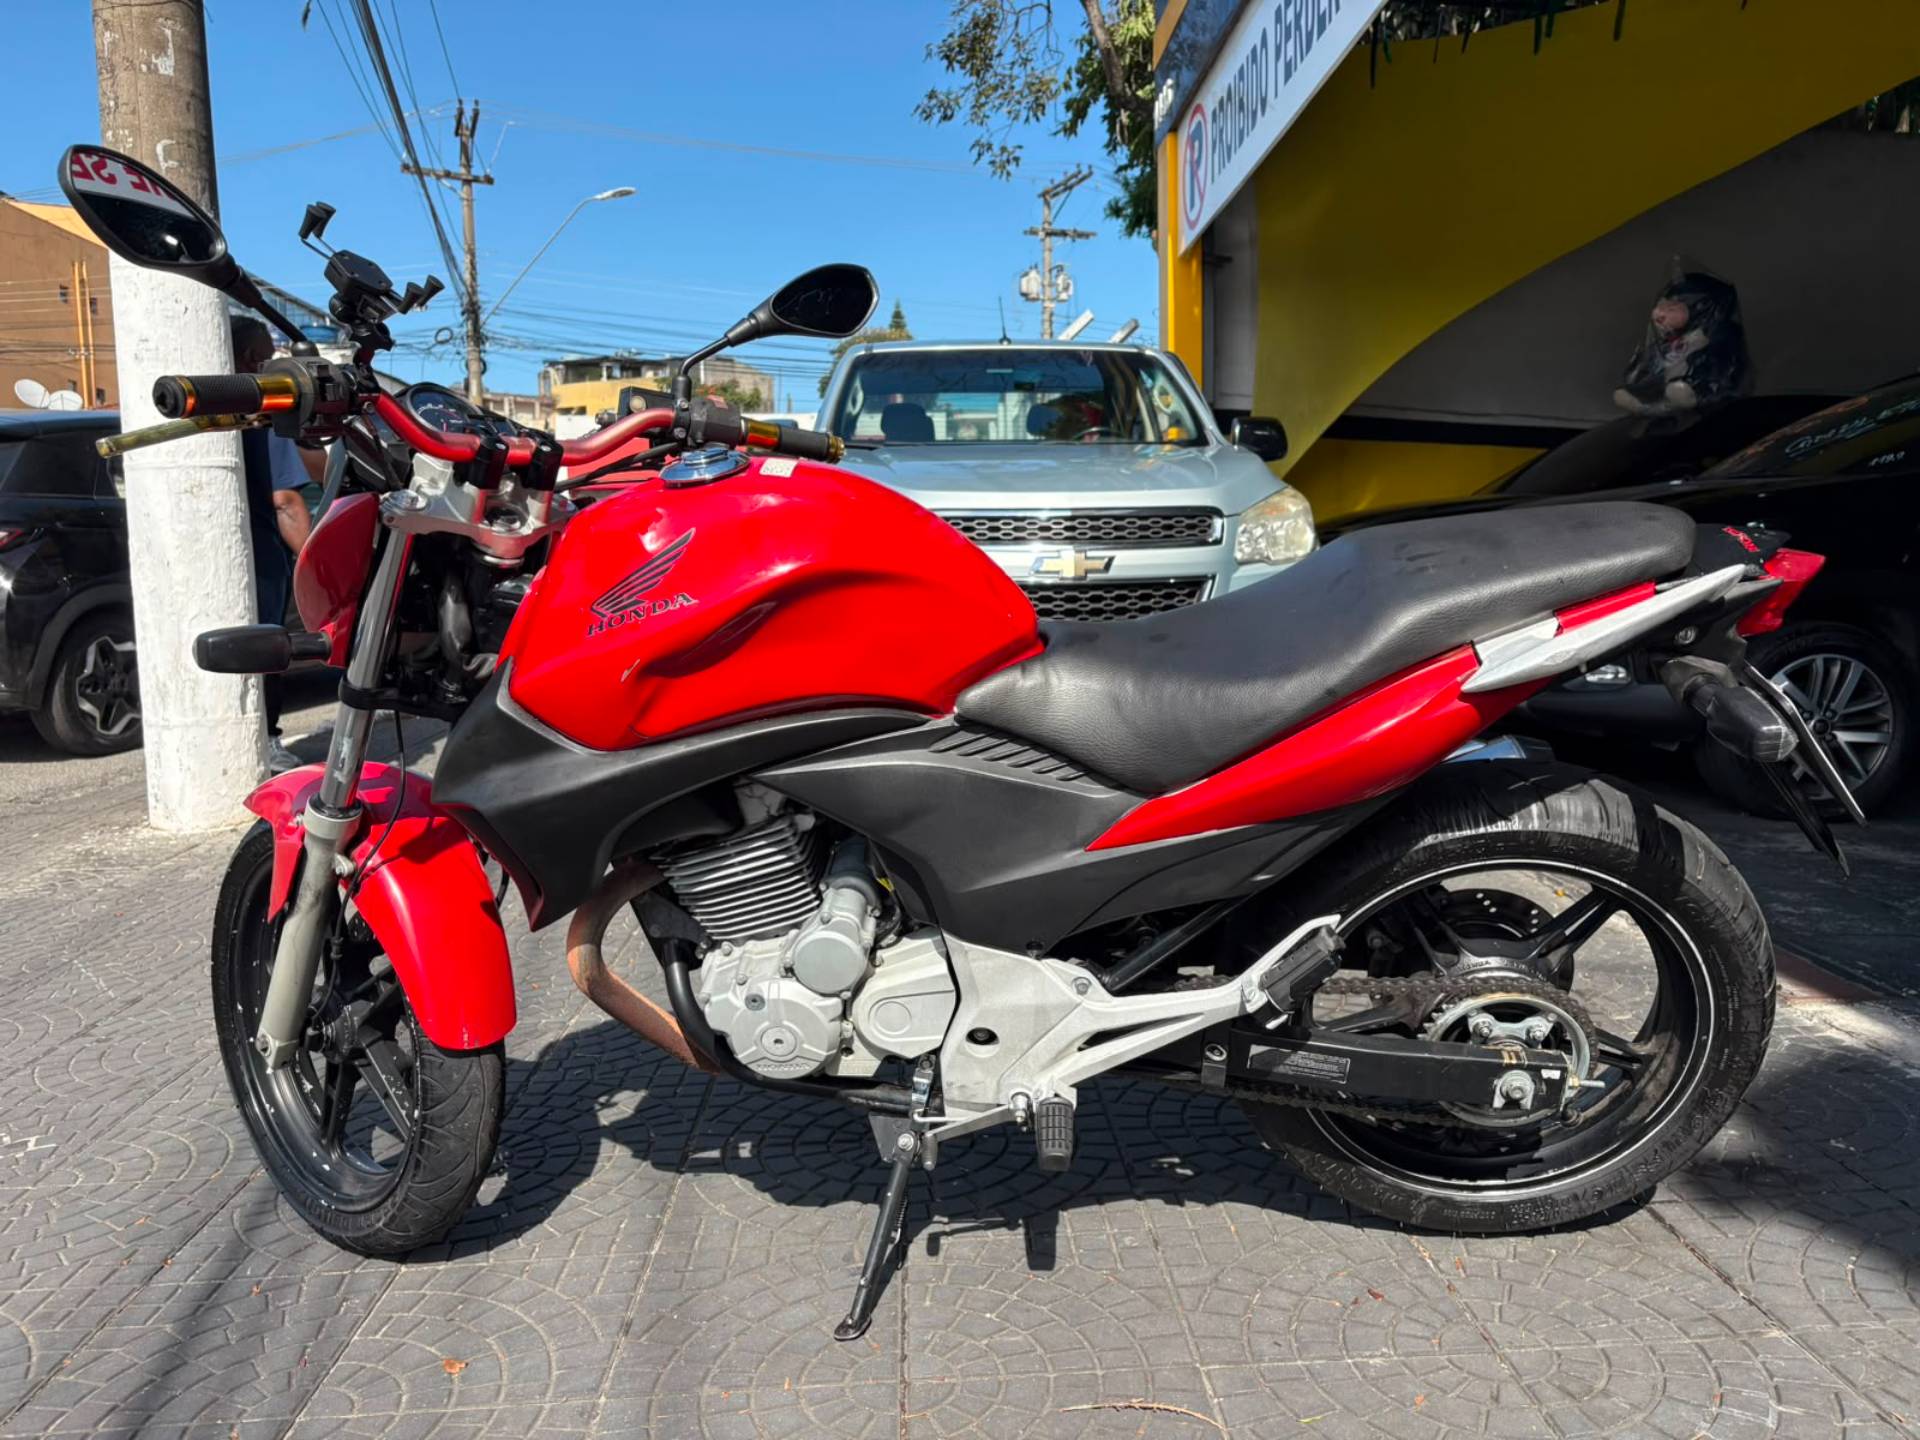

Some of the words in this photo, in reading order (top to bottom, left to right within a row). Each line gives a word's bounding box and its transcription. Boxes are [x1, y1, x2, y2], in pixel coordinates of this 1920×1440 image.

[1210, 27, 1269, 184] PROIBIDO
[1274, 0, 1341, 99] PERD
[588, 592, 698, 636] HONDA
